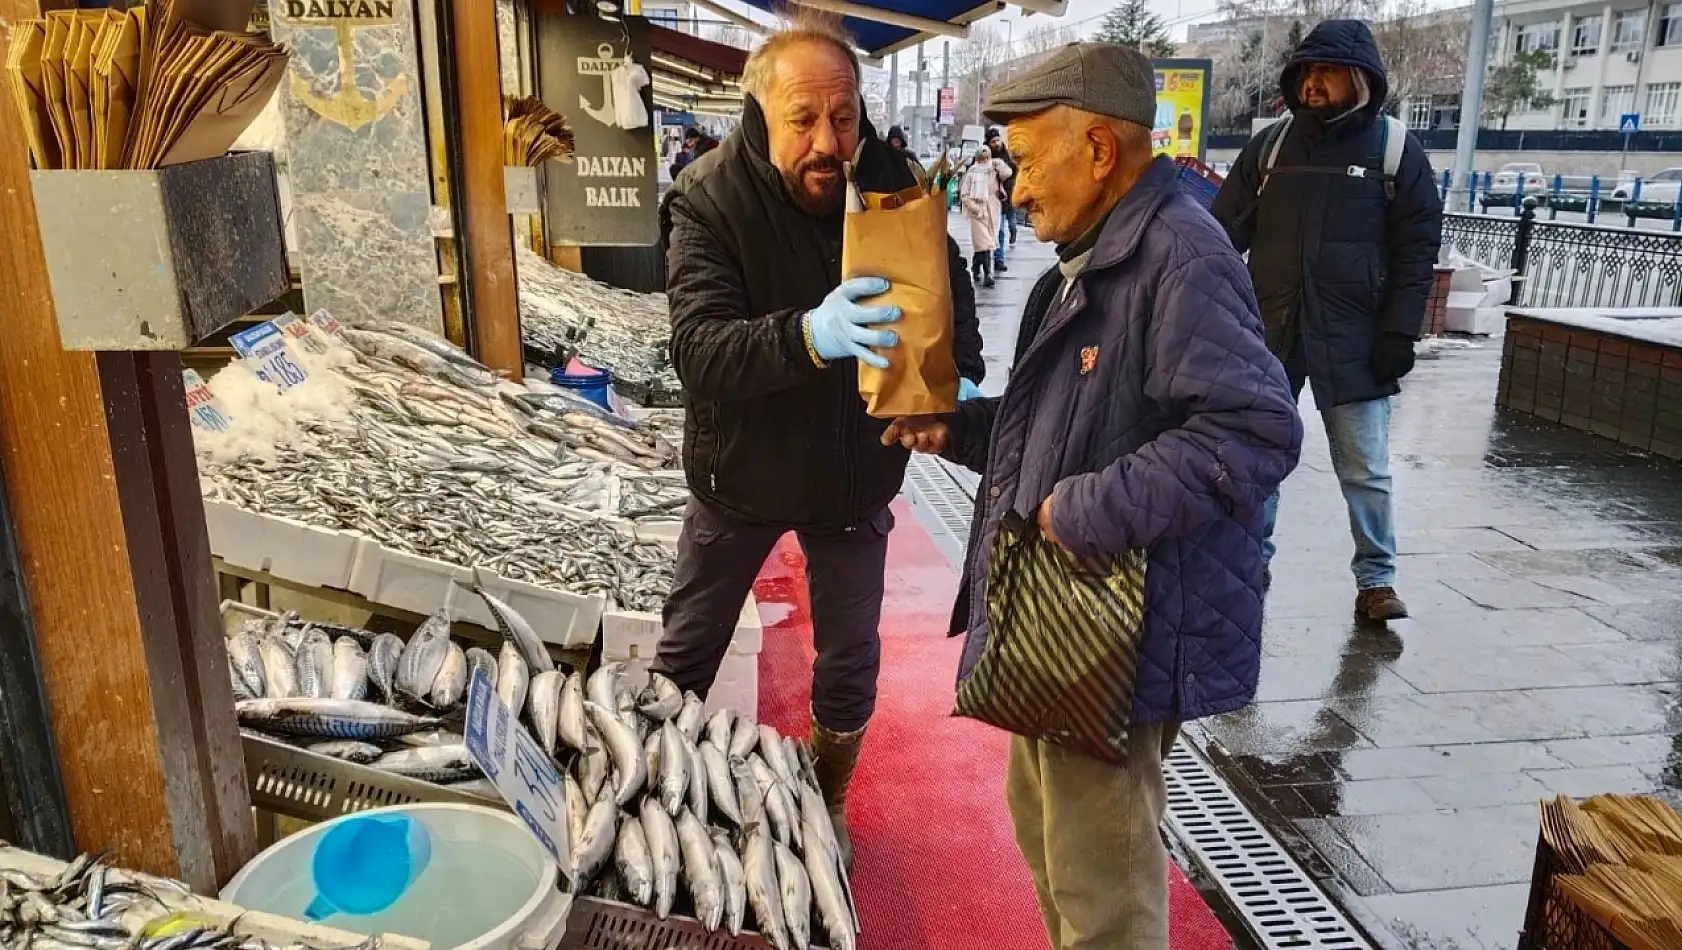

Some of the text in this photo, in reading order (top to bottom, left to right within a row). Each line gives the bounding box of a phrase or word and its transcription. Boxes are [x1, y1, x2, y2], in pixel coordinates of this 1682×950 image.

[286, 0, 393, 18] DALYAN
[580, 61, 621, 72] DALYA
[577, 156, 645, 177] DALYAN
[585, 186, 641, 207] BALIK
